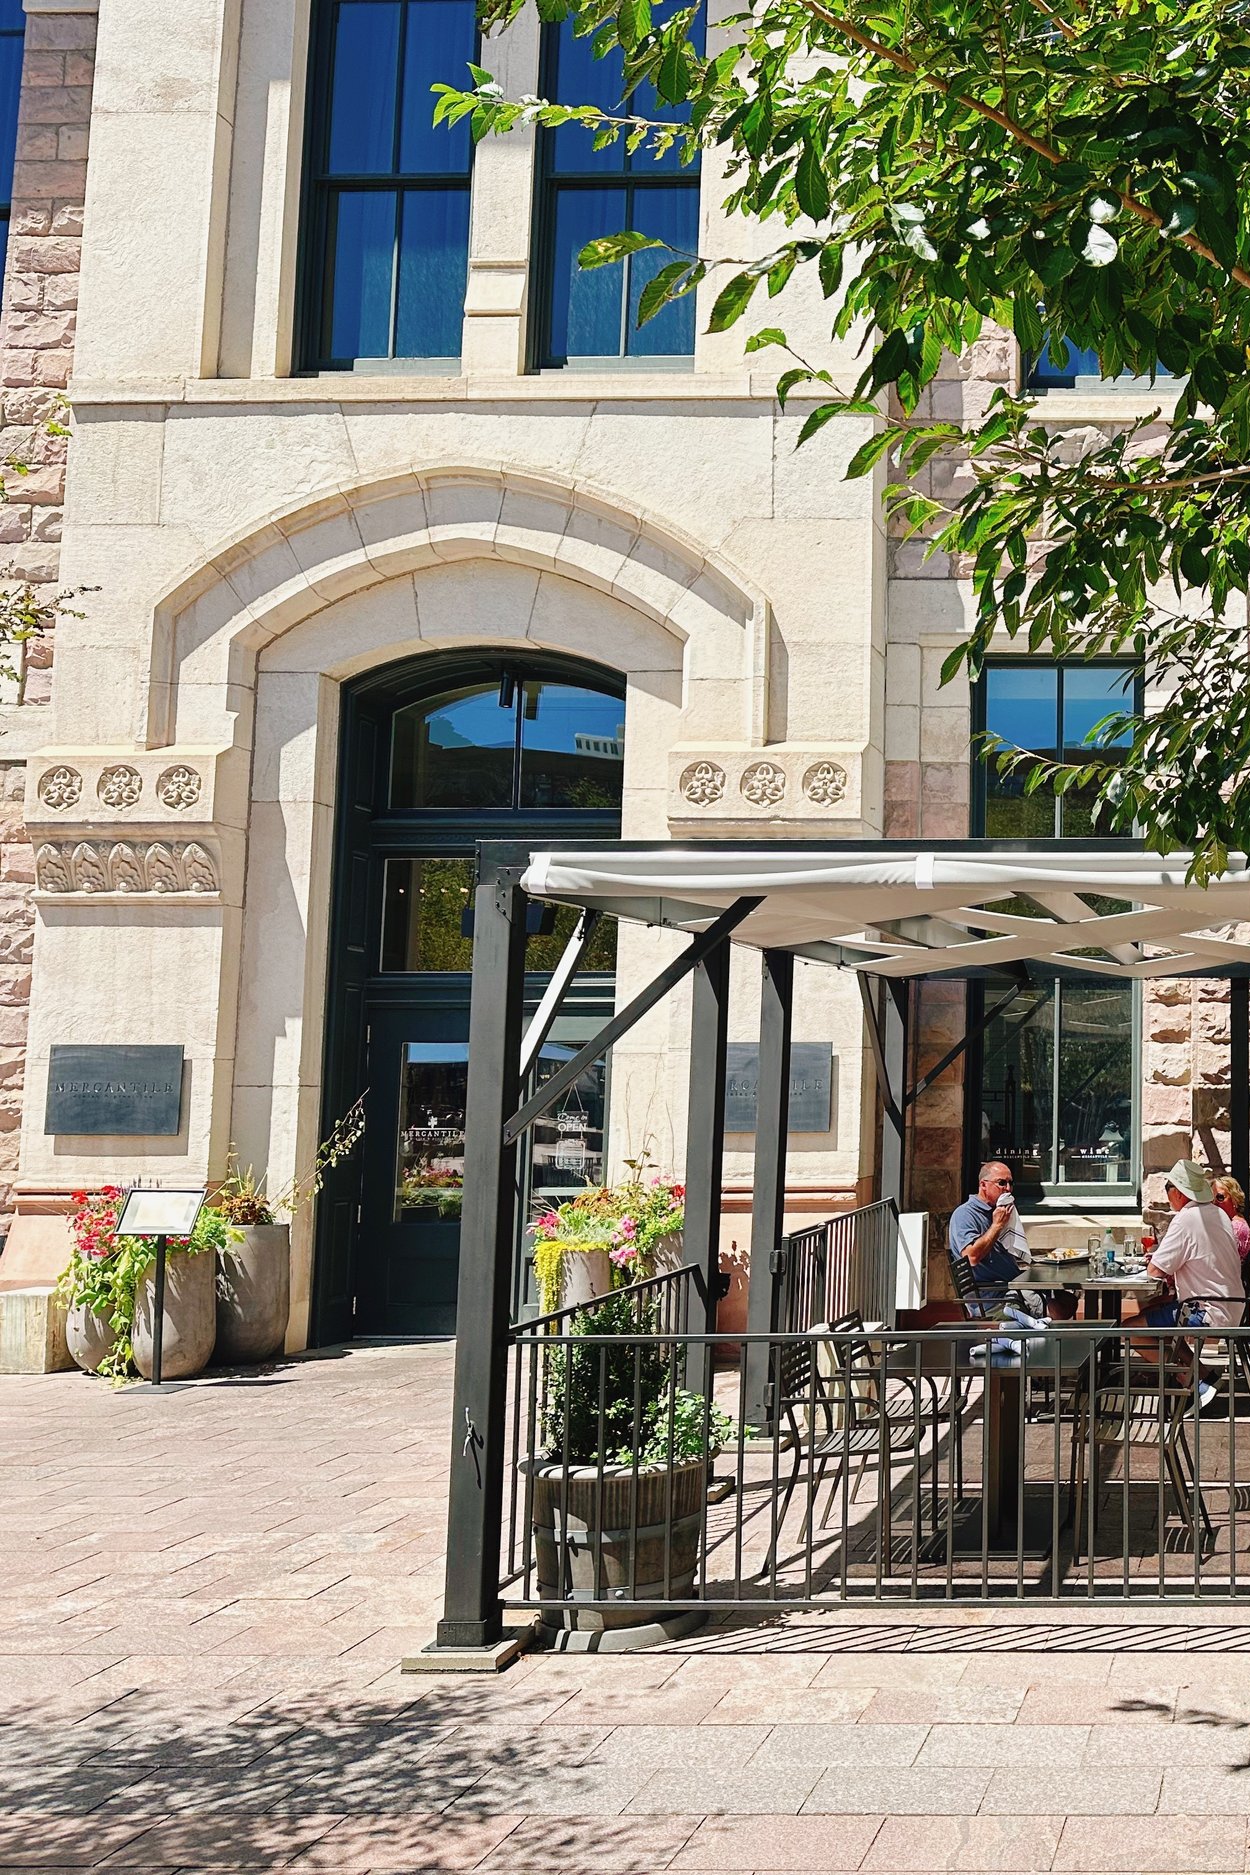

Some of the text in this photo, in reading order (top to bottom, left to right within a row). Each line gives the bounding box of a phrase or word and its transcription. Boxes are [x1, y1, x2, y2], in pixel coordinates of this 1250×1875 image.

[55, 1082, 174, 1093] MERCANTILE
[558, 1122, 587, 1132] OPEN
[995, 1147, 1038, 1156] dining
[1080, 1146, 1110, 1155] wine
